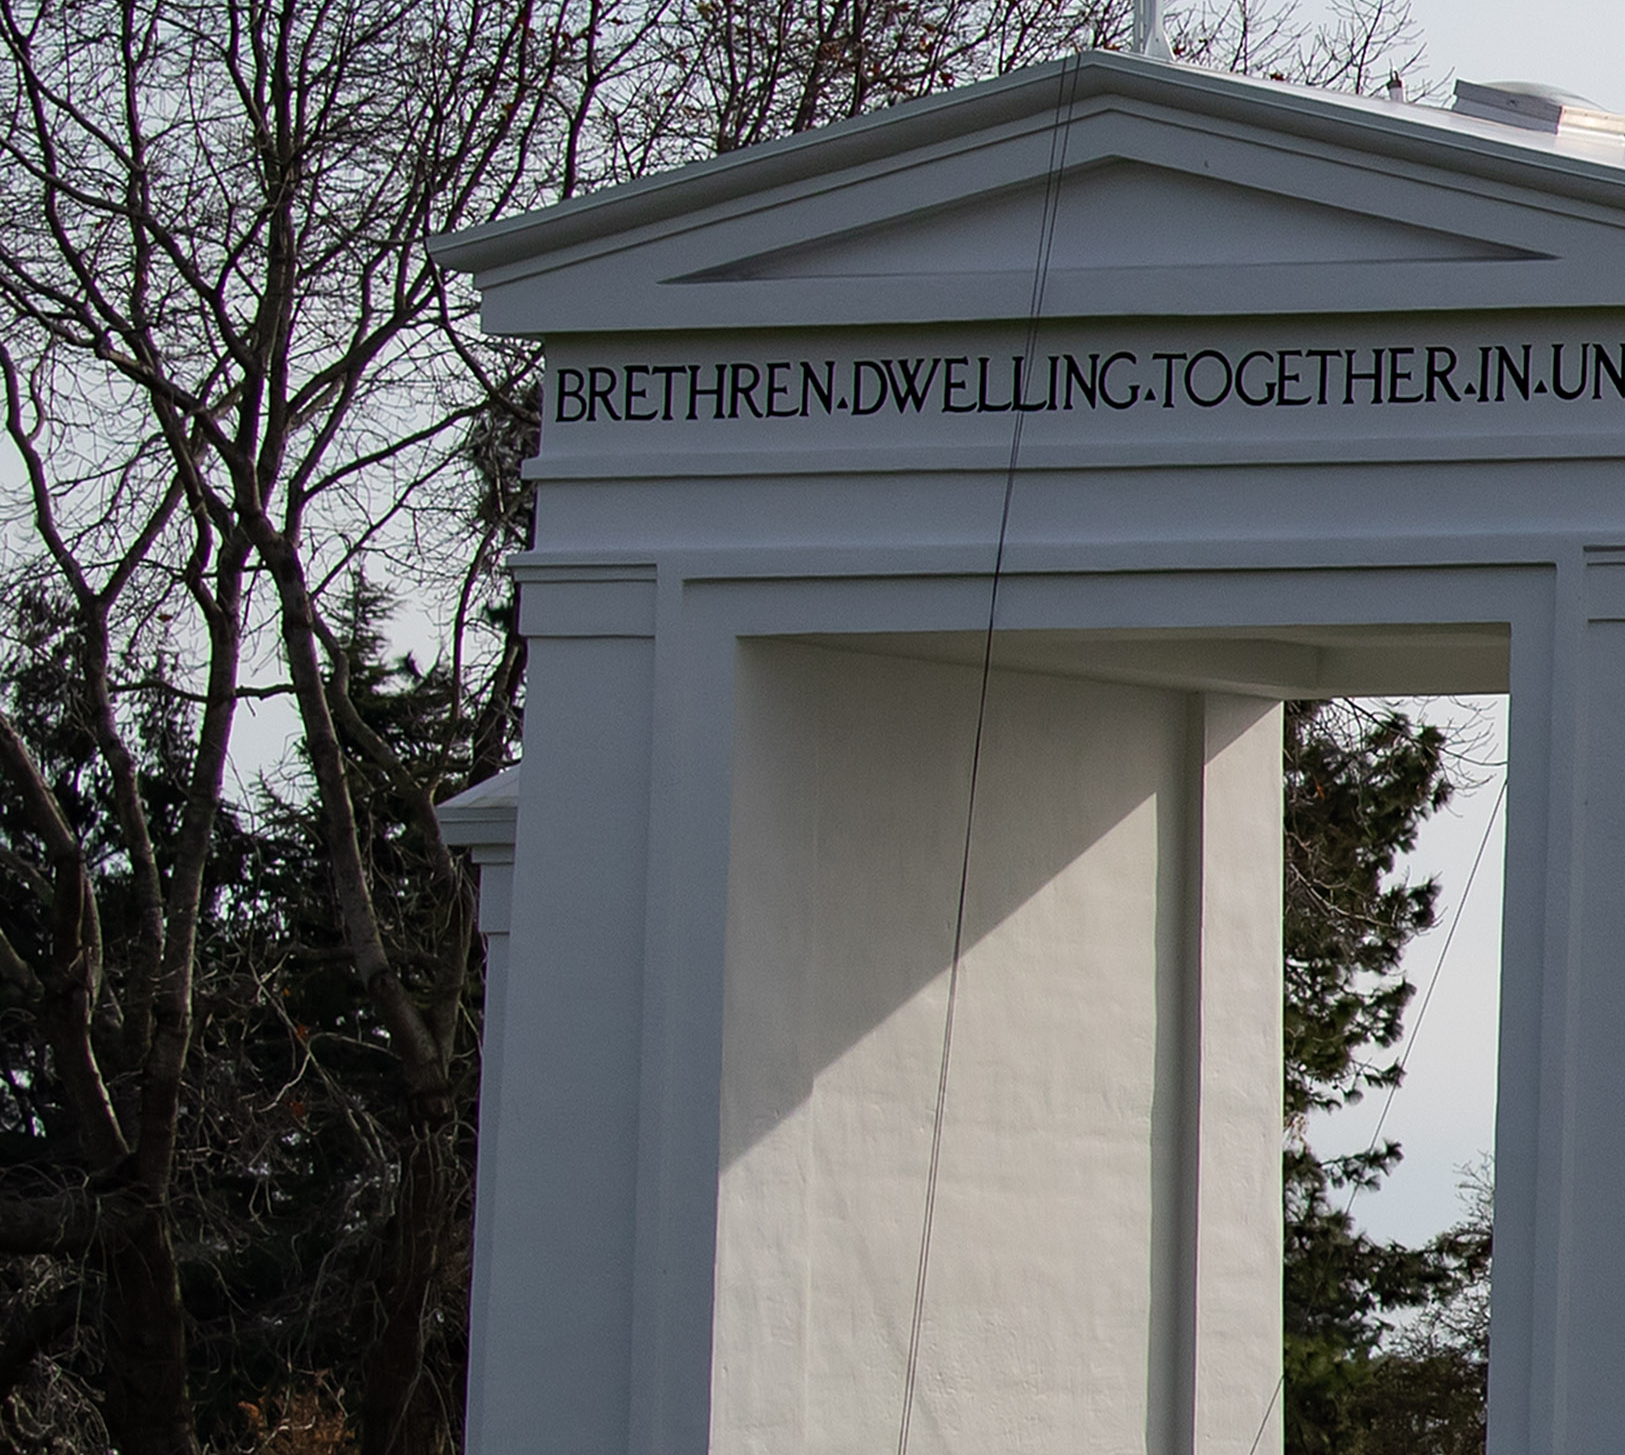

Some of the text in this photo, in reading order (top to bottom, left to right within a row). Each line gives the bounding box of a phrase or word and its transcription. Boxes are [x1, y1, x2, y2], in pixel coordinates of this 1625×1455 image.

[556, 361, 832, 422] BRETHREN
[851, 351, 1140, 416] DWELLING
[1152, 346, 1462, 408] TOGETHER
[1476, 344, 1532, 402] IN
